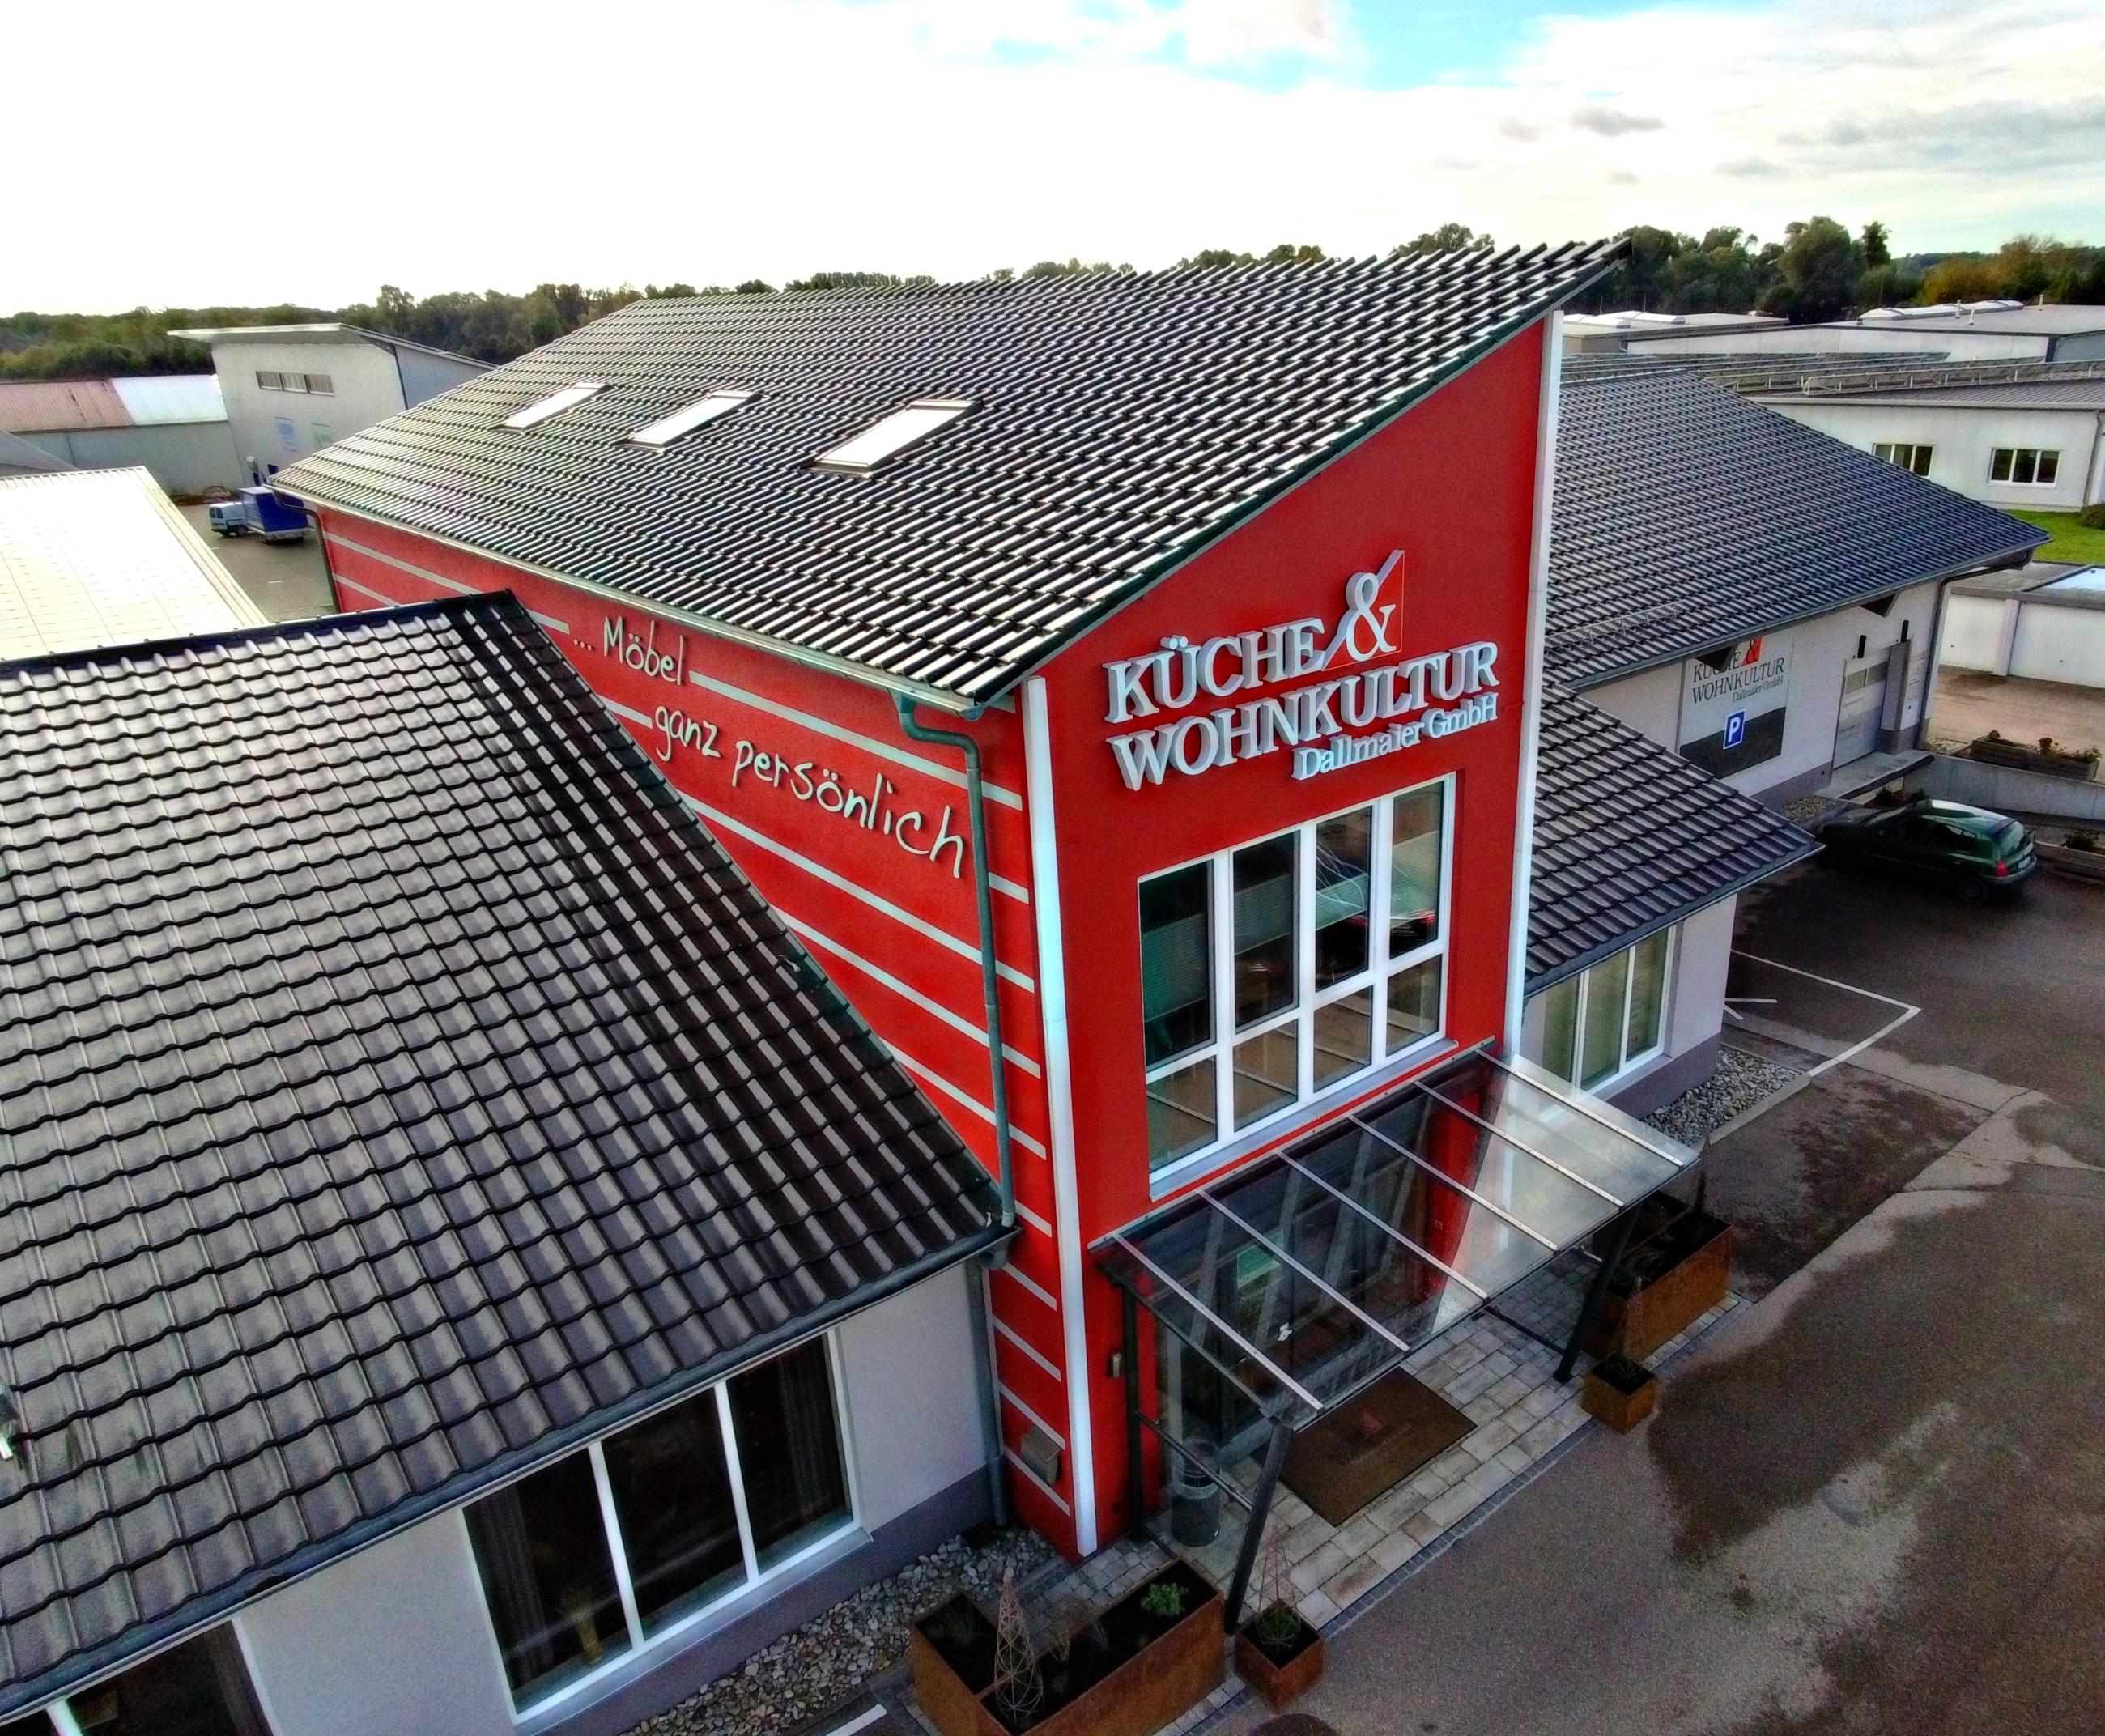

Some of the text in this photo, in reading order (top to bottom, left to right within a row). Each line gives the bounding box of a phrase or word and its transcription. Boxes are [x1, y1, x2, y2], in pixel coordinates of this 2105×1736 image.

[603, 615, 684, 686] Möbel
[1103, 571, 1397, 723] KÜCHE &
[1692, 657, 1784, 704] WOHNKULTUR
[1106, 641, 1500, 790] WOHNKULTUR
[1291, 691, 1499, 780] Dallmaier GmbH
[1727, 716, 1740, 742] P
[654, 704, 964, 879] ganz persönlich
